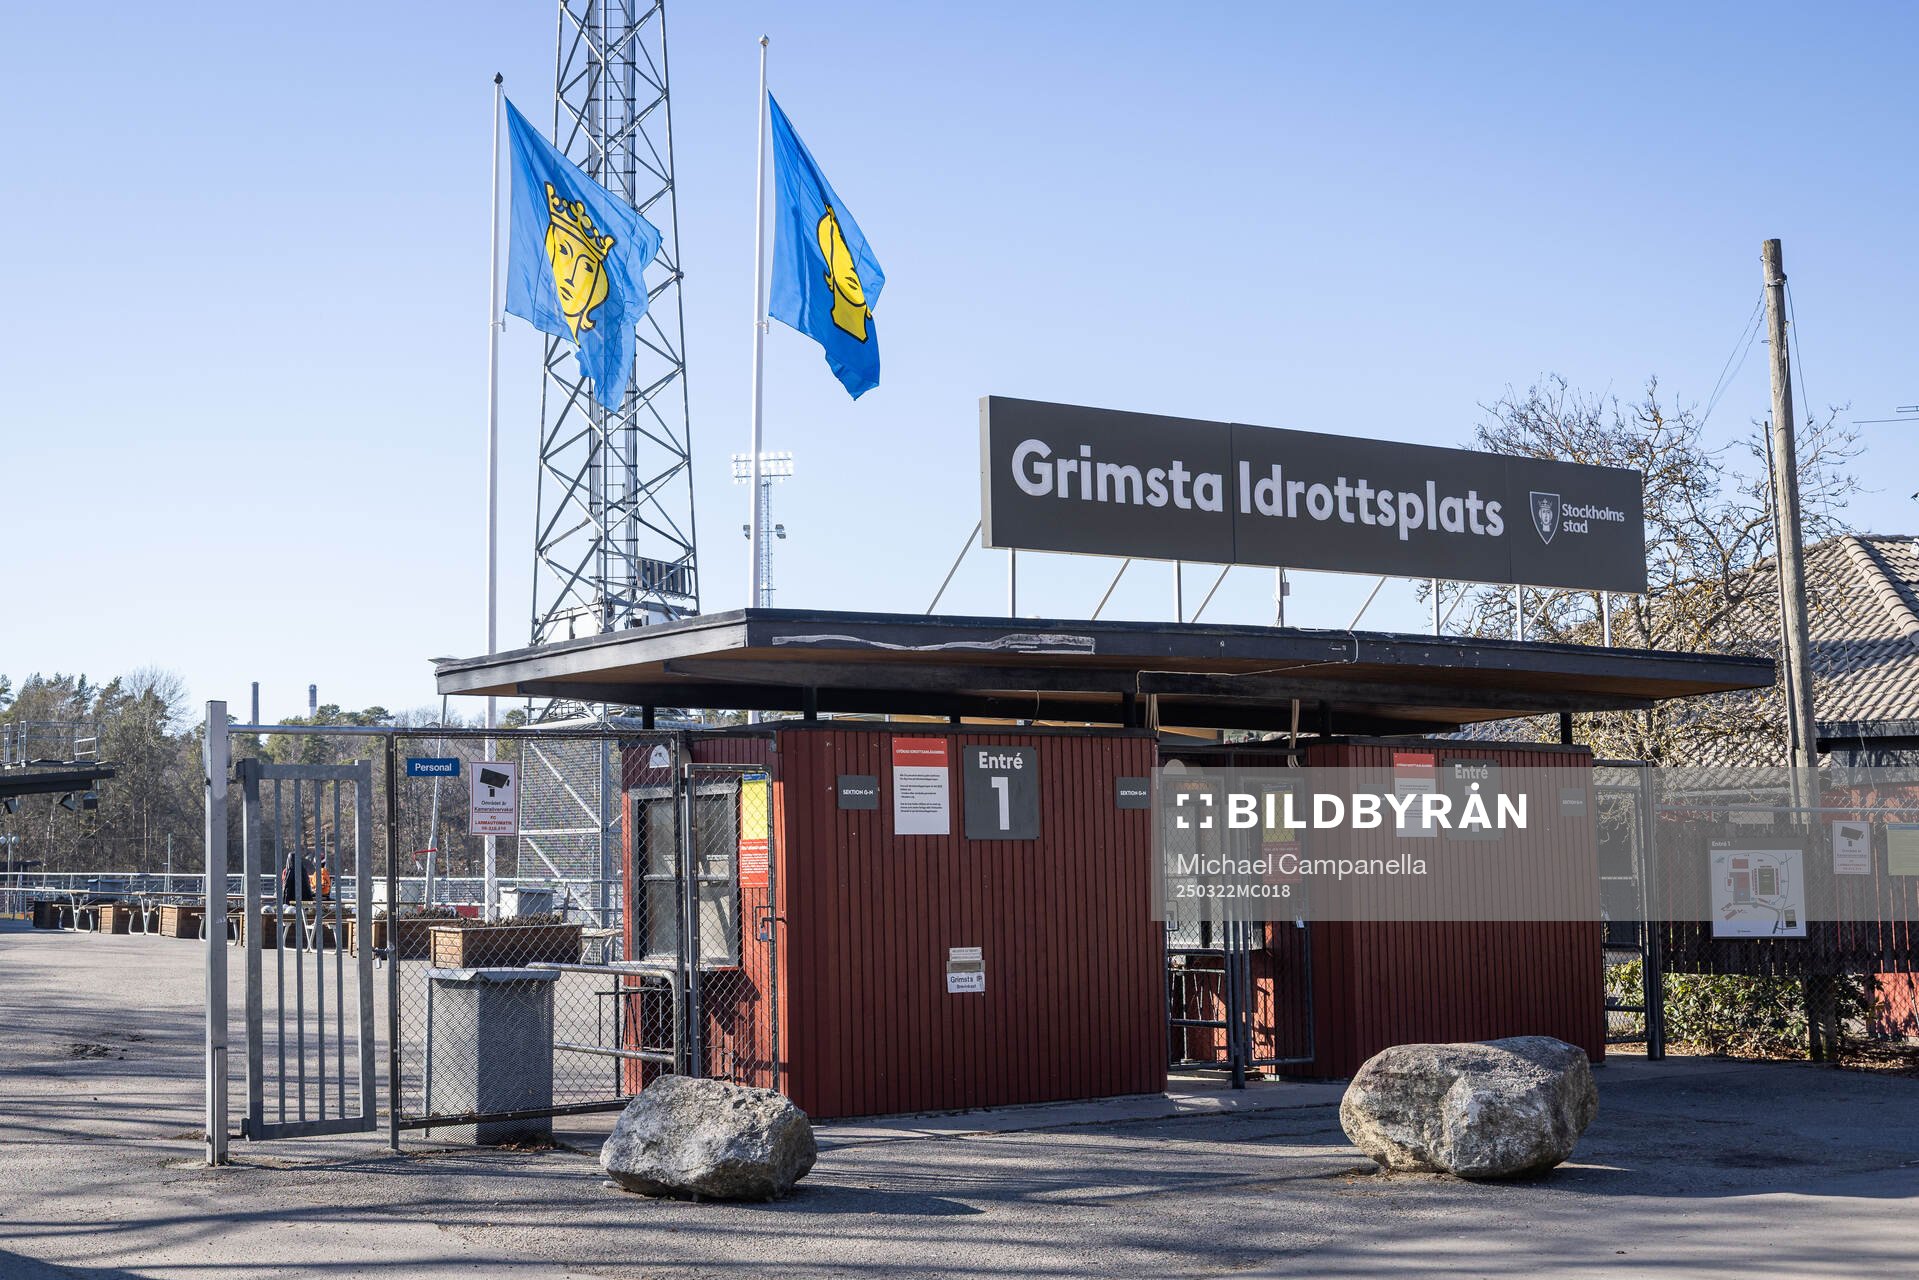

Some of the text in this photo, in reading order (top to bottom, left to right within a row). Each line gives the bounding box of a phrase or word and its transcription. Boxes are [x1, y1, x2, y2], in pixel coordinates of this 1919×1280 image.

[1011, 438, 1504, 541] Grimsta Idrottsplats
[1561, 503, 1625, 522] Stockholms
[1563, 519, 1588, 534] stad
[414, 762, 452, 772] Personal
[978, 751, 1024, 770] Entré
[1454, 763, 1489, 779] Entré
[991, 776, 1010, 831] 1
